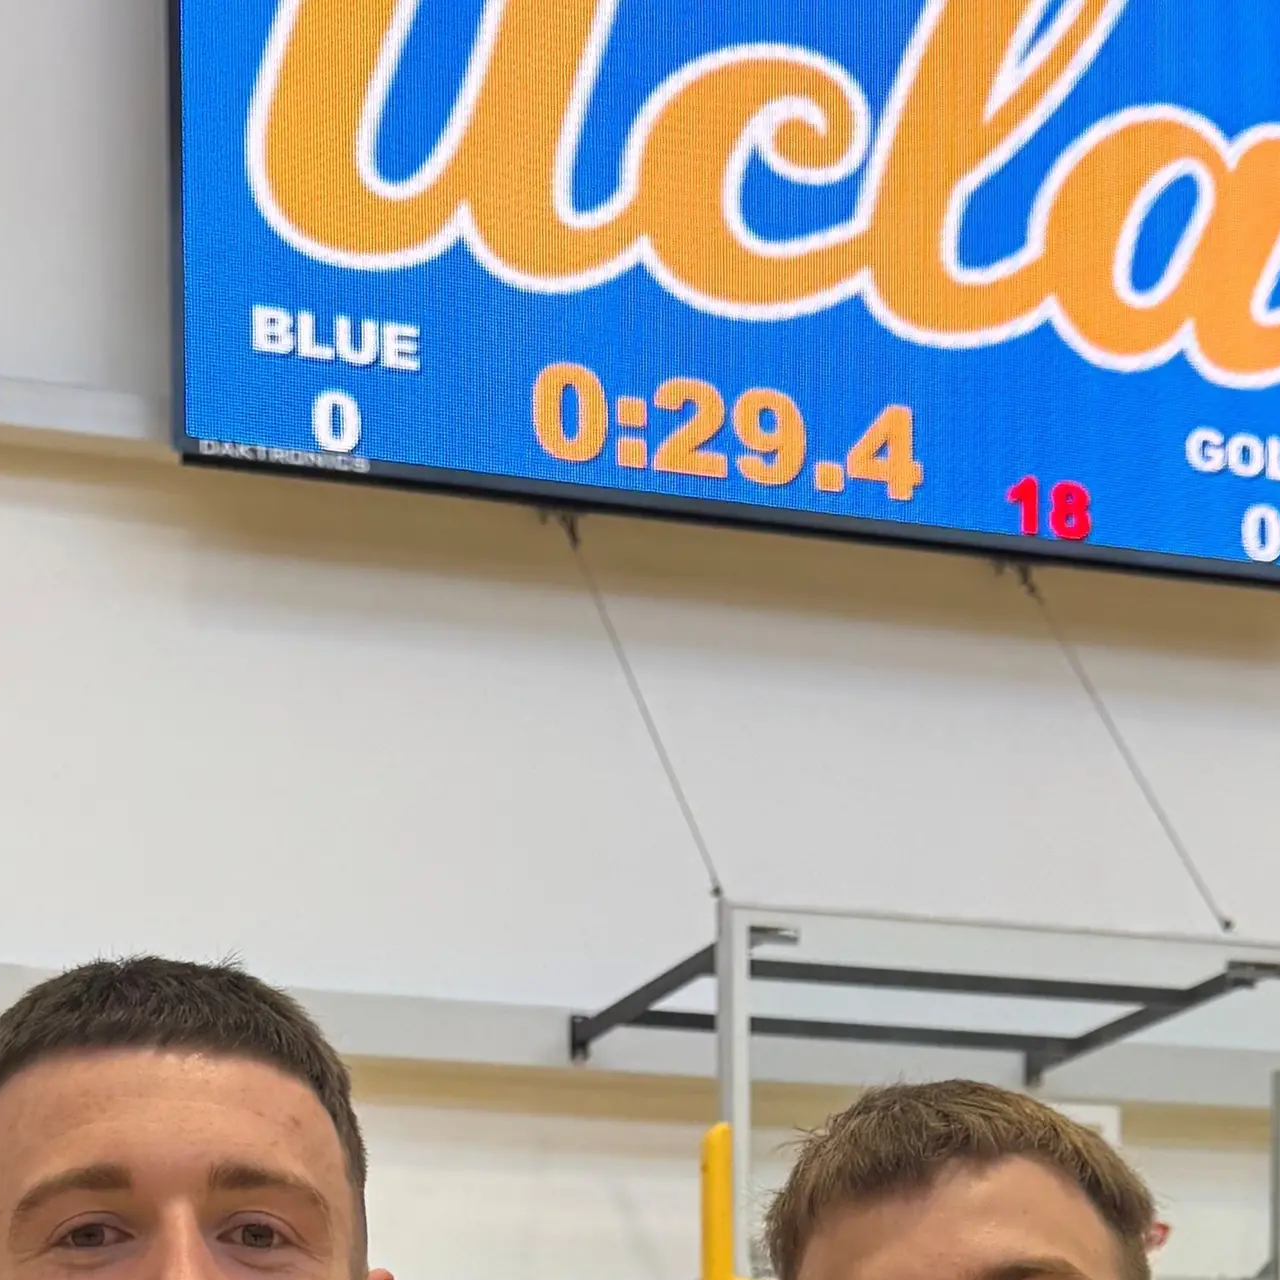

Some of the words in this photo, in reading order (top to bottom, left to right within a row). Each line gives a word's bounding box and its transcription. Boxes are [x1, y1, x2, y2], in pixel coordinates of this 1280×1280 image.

[252, 304, 420, 372] BLUE
[312, 388, 362, 453] 0
[531, 362, 923, 501] 0:29.4
[199, 439, 370, 474] DAKTRONICS
[1007, 476, 1092, 541] 18
